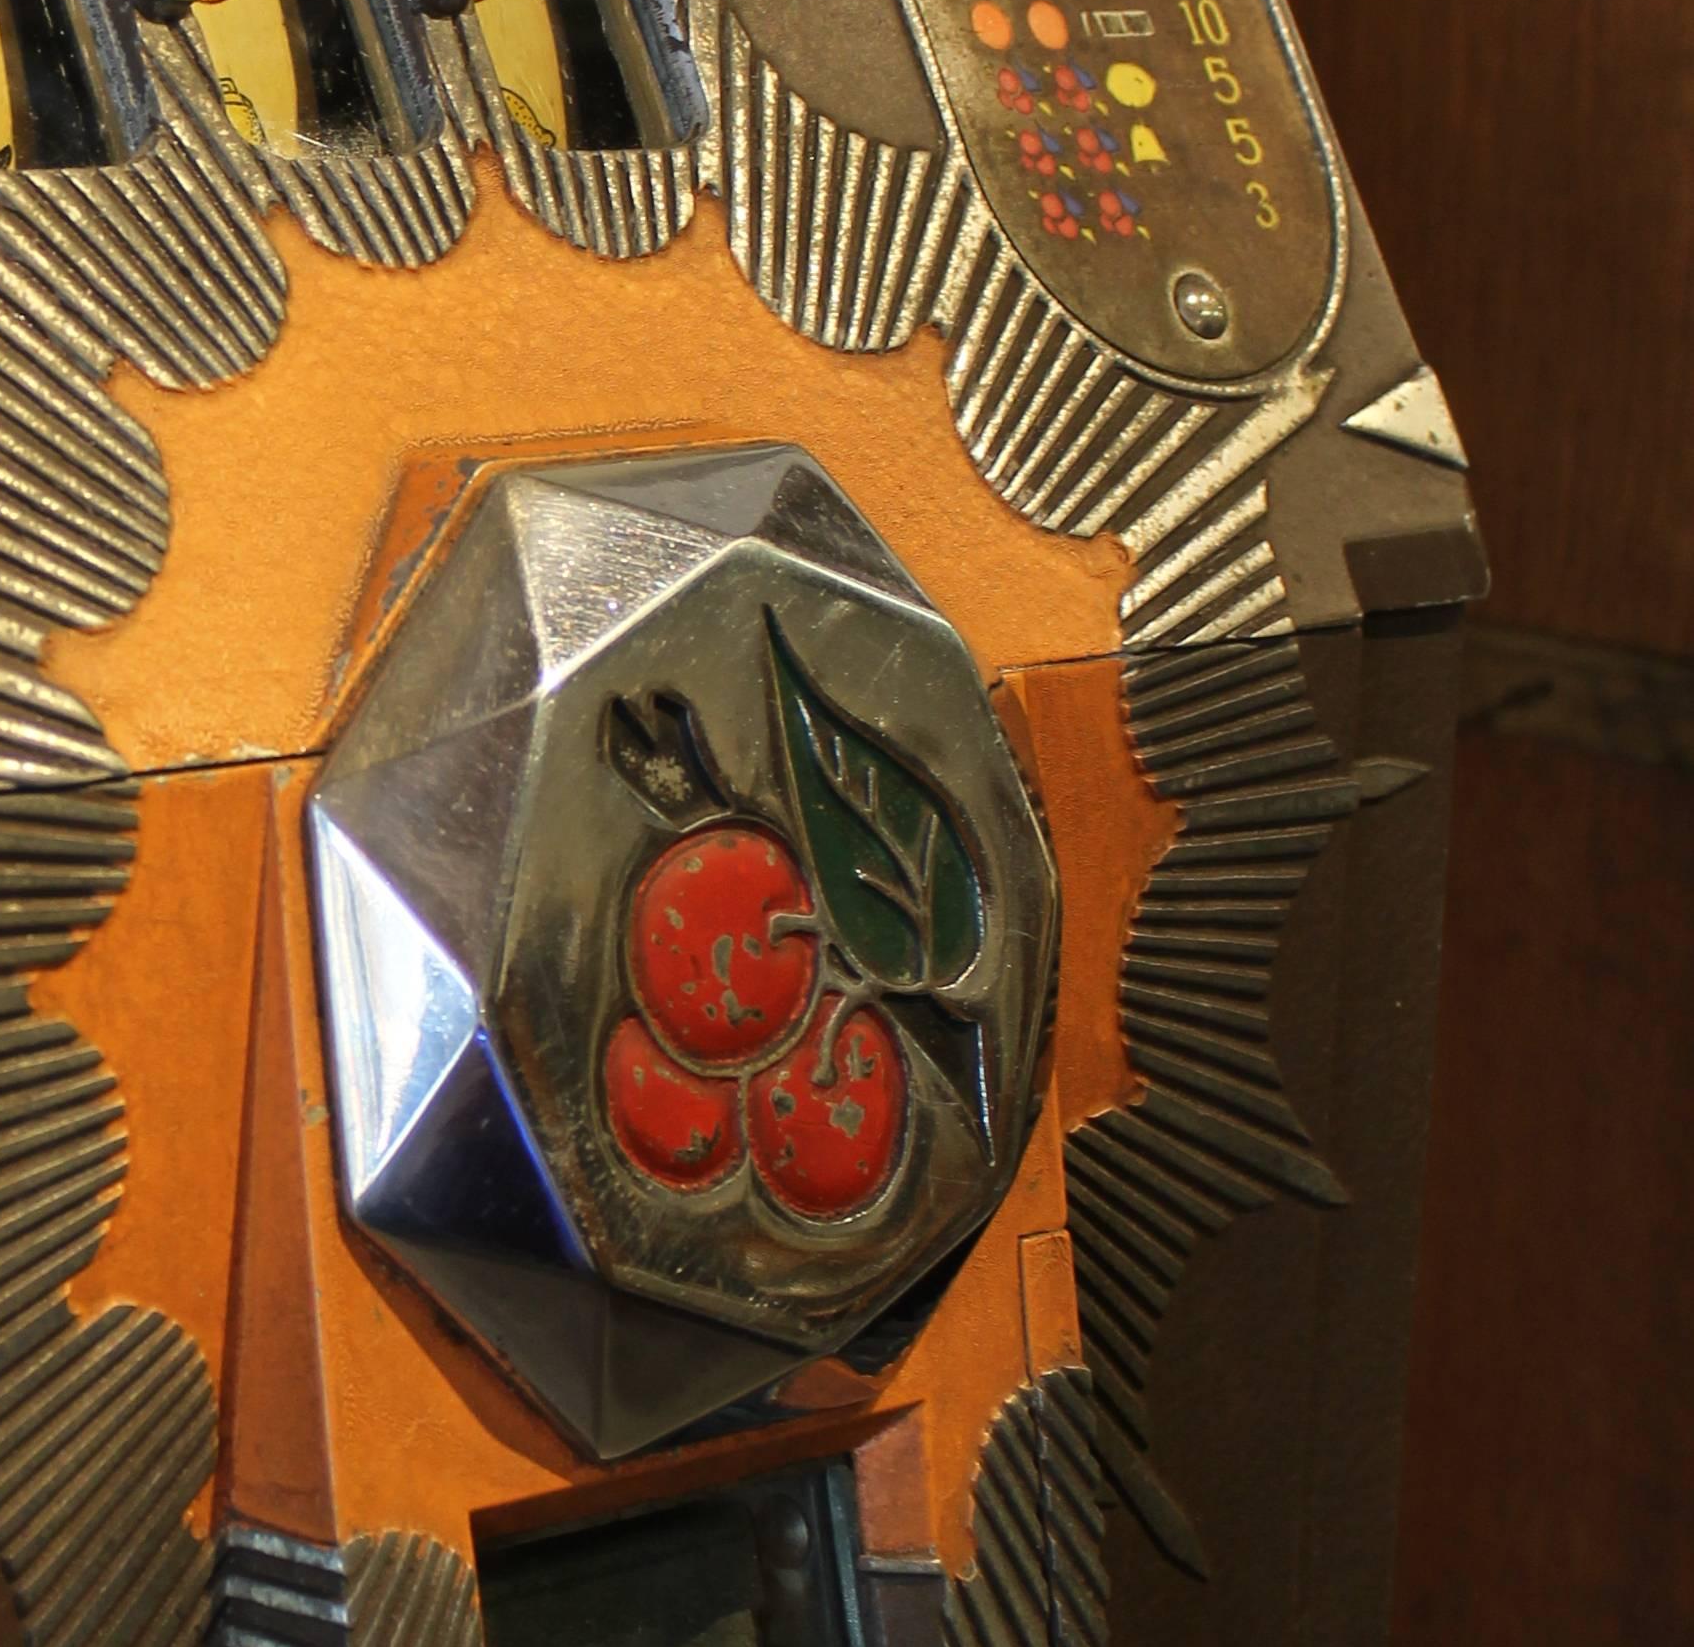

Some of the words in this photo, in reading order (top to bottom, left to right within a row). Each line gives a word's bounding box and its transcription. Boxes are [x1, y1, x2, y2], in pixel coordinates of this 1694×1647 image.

[1203, 56, 1242, 105] 5
[1224, 117, 1264, 166] 5
[1245, 181, 1280, 230] 3
